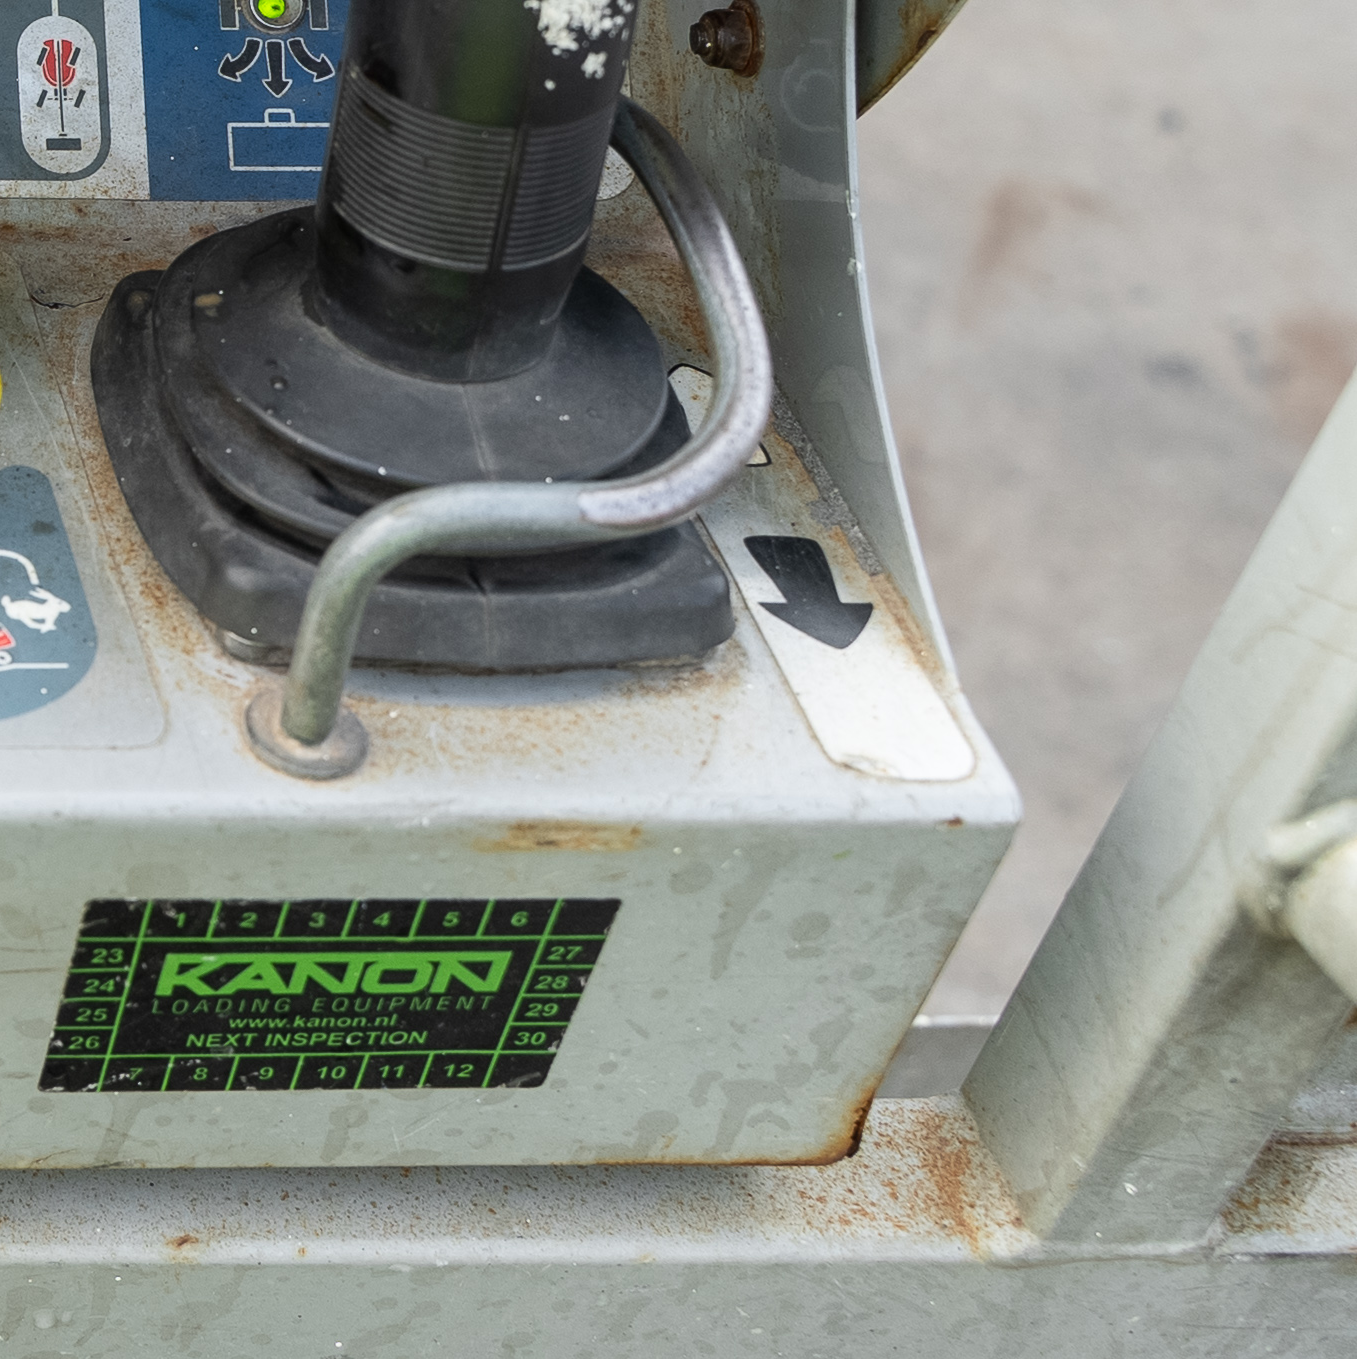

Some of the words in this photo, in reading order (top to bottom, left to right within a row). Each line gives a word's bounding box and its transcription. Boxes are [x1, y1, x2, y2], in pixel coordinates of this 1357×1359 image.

[176, 912, 186, 928] 1
[239, 912, 258, 928] 2
[309, 912, 327, 928] 3
[373, 912, 391, 927] 4
[443, 911, 461, 927] 5
[511, 911, 529, 927] 6
[91, 948, 124, 964] 23
[546, 946, 583, 961] 27
[155, 951, 513, 996] KANON
[83, 978, 115, 993] 24
[534, 975, 569, 990] 28
[151, 997, 292, 1015] LOADING
[312, 995, 495, 1013] EQUIPMENT
[524, 1003, 558, 1017] 29
[75, 1008, 108, 1022] 25
[229, 1013, 397, 1028] www.kanon.nl
[68, 1036, 100, 1050] 26
[186, 1032, 258, 1048] NEXT
[264, 1031, 428, 1046] INSPECTION
[514, 1031, 546, 1046] 30
[129, 1068, 143, 1080] 7
[193, 1067, 208, 1080] 8
[259, 1066, 274, 1080] 9
[317, 1066, 347, 1079] 10
[378, 1065, 406, 1078] 11
[443, 1064, 474, 1078] 12
